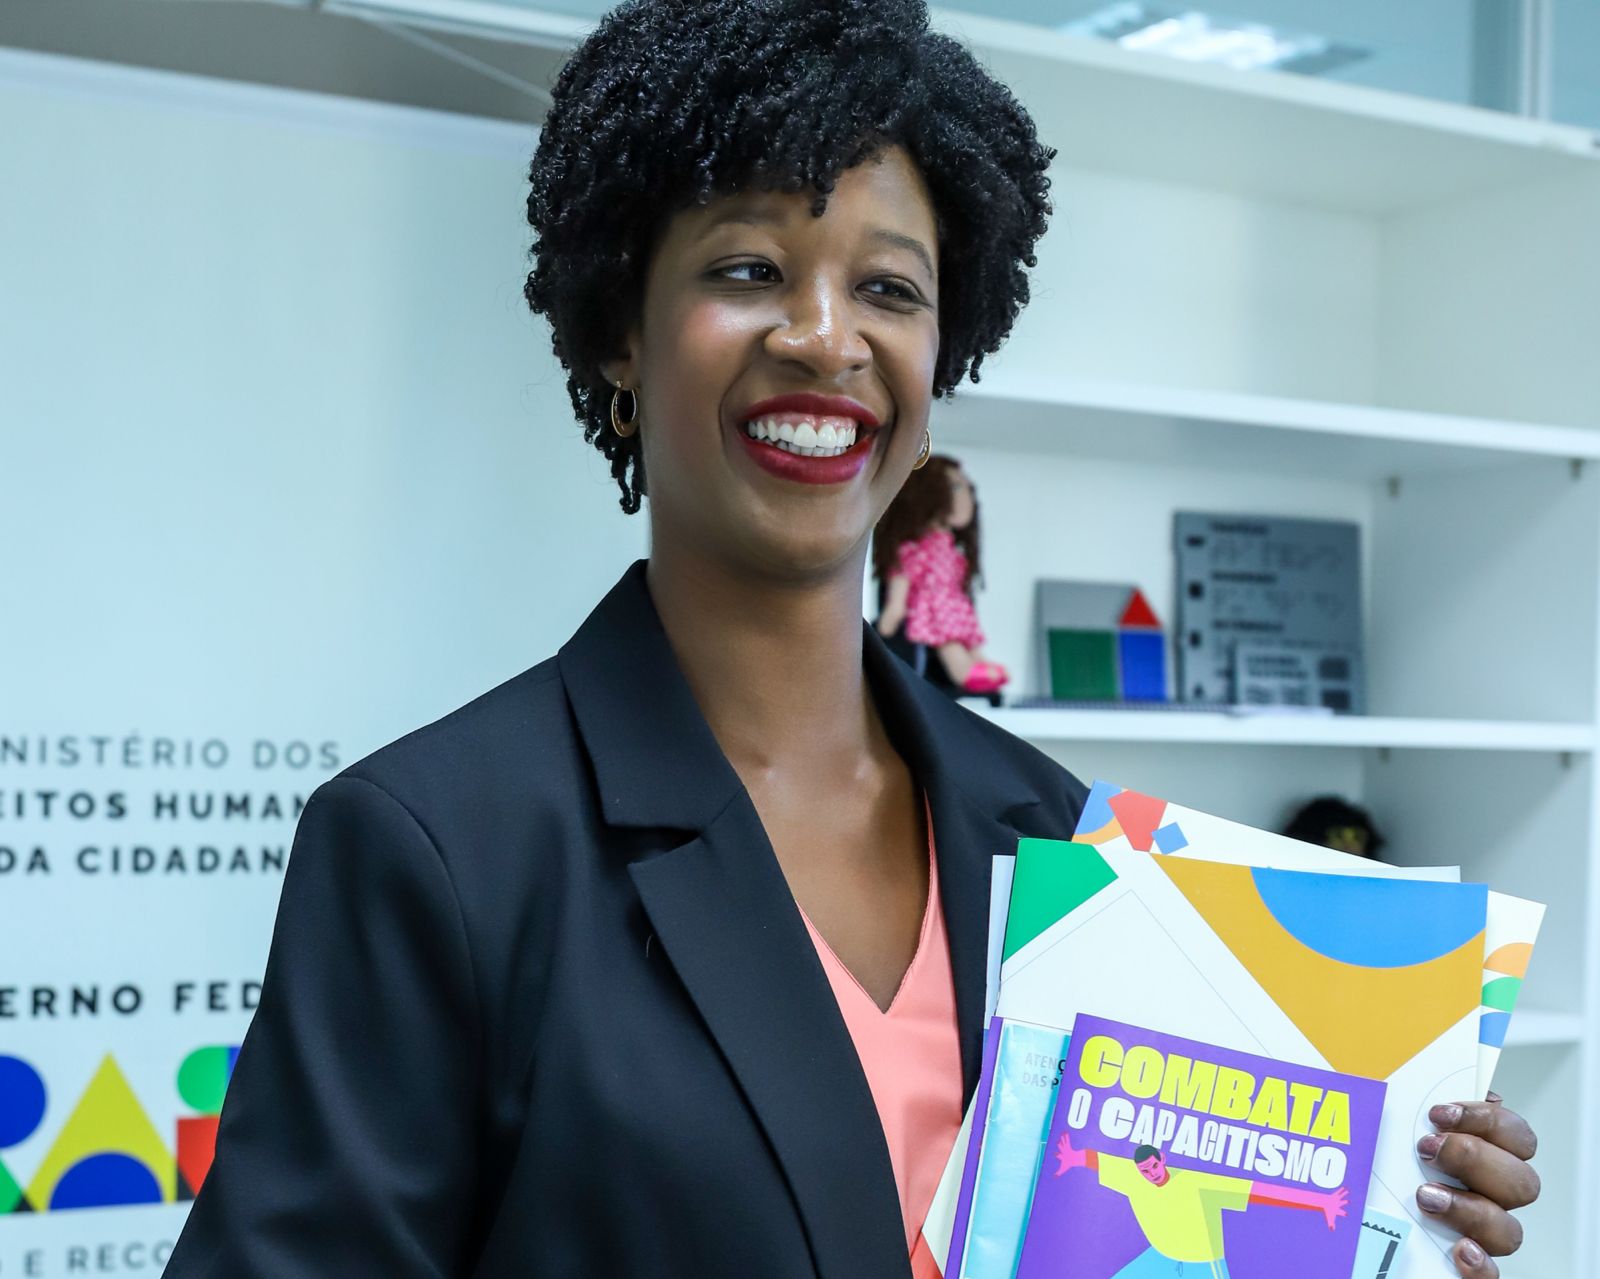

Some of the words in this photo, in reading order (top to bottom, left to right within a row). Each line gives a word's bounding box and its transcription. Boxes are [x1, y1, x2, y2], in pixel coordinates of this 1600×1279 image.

[1, 729, 230, 770] NISTÉRIO
[252, 738, 341, 770] DOS
[0, 791, 128, 820] ITOS
[77, 846, 284, 874] CIDADAN
[0, 984, 143, 1018] ERNO
[174, 981, 262, 1013] FED
[1022, 1071, 1048, 1088] DAS
[1079, 1035, 1351, 1145] COMBATA
[1067, 1088, 1093, 1130] O
[1099, 1096, 1347, 1190] CAPACITISMO
